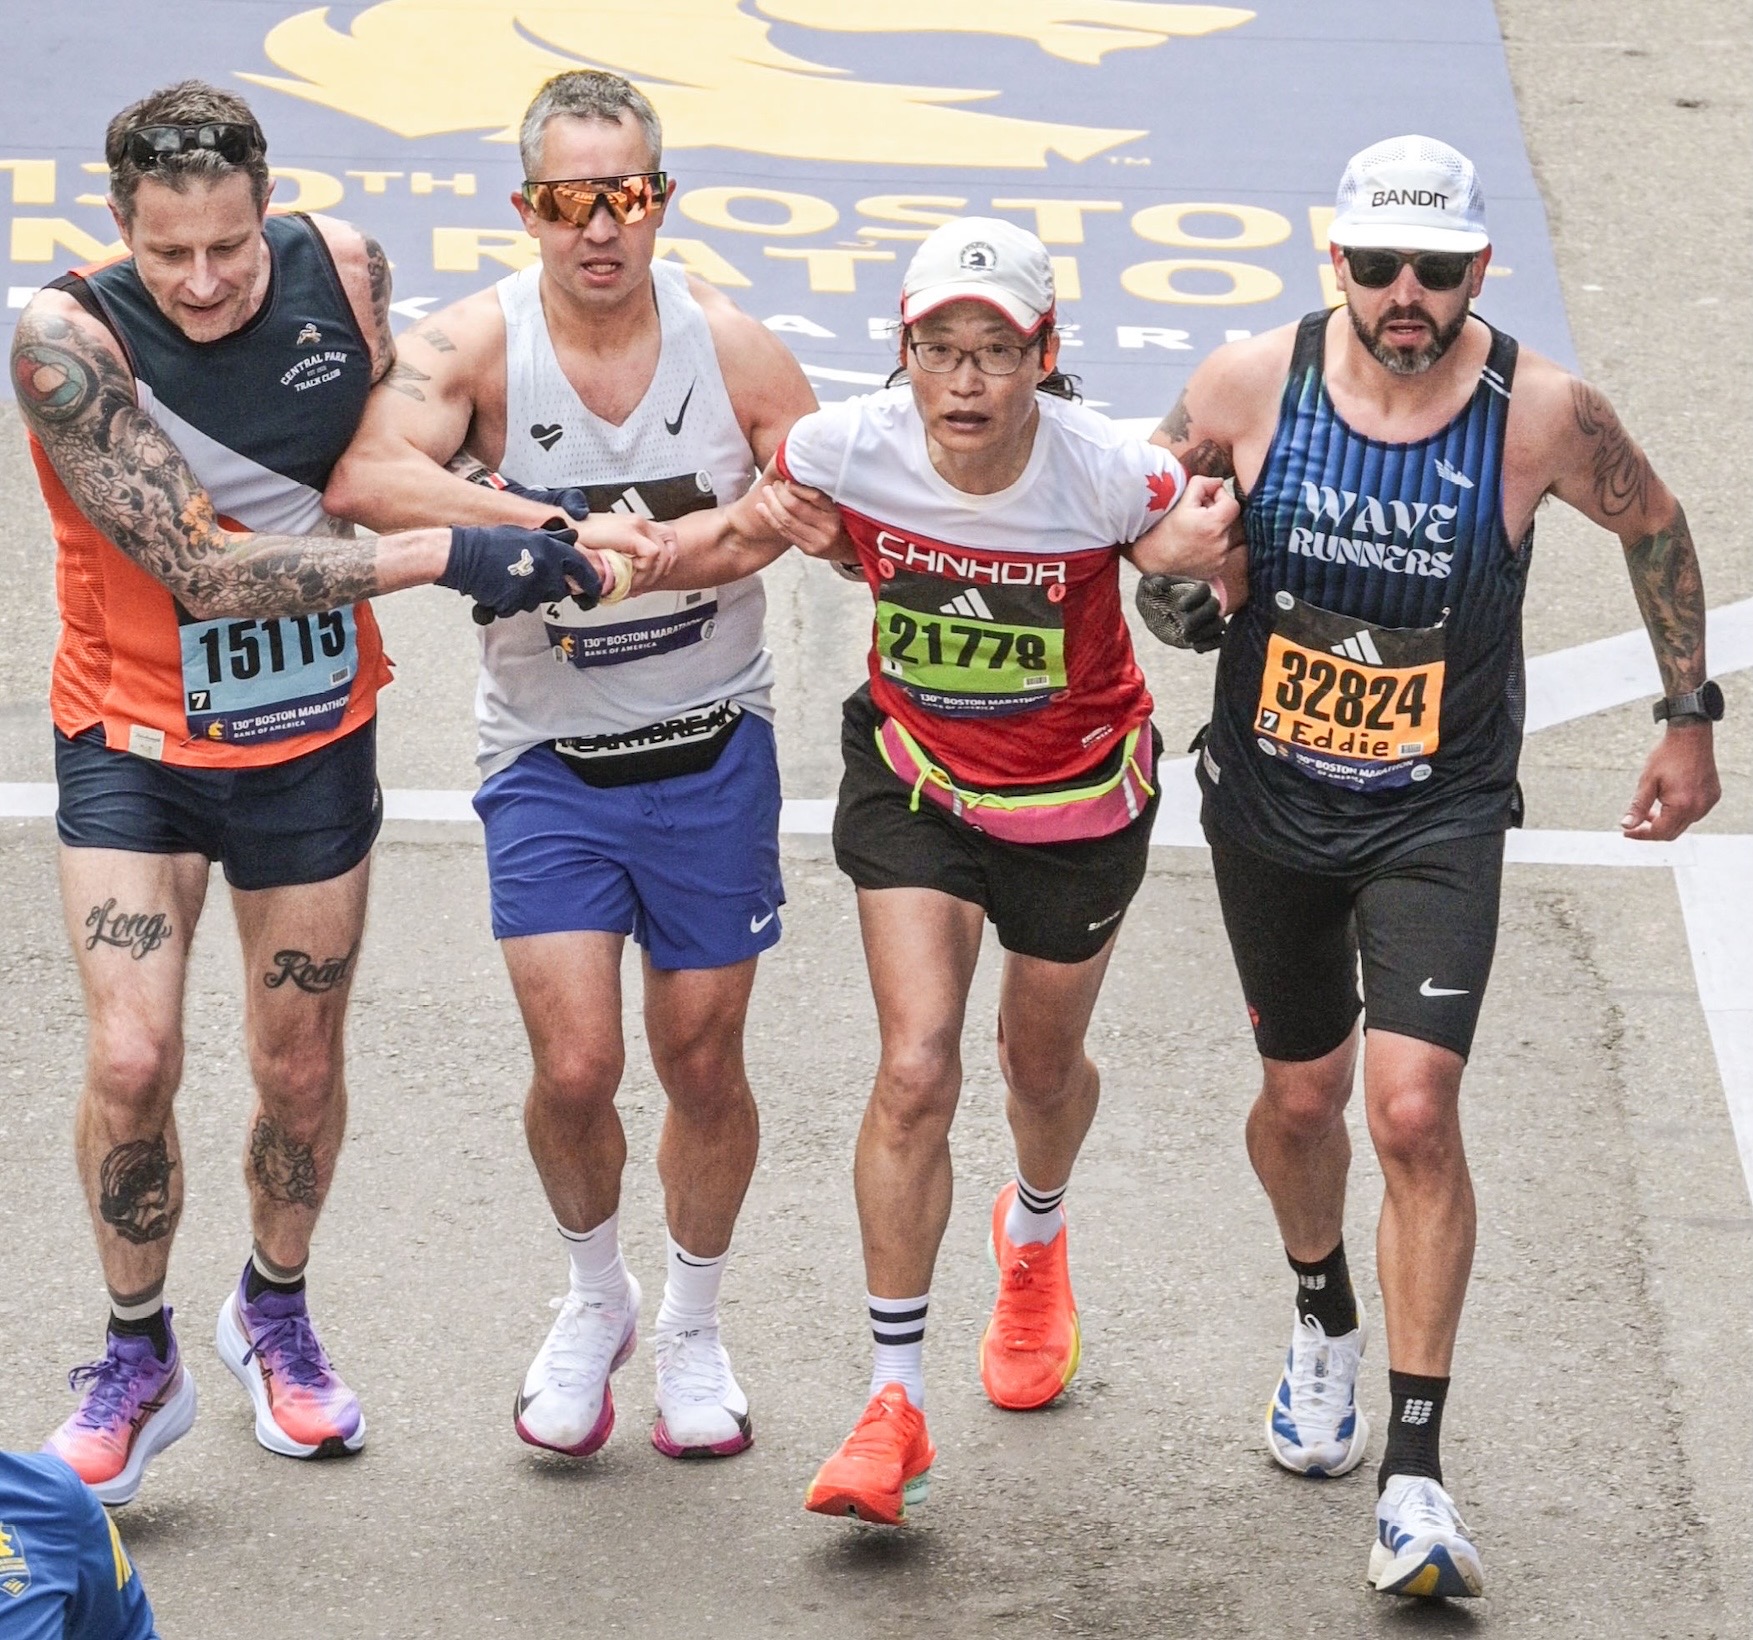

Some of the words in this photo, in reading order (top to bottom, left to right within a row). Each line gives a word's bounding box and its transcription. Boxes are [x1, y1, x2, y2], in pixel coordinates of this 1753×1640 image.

[1371, 189, 1449, 210] BANDIT
[280, 354, 324, 386] CENTRAL
[324, 351, 348, 363] PARK
[294, 376, 322, 391] TRACK
[321, 368, 341, 383] CLUB
[1301, 481, 1458, 543] WAVE
[1288, 526, 1454, 579] RUNNERS
[546, 603, 560, 619] 4
[199, 610, 345, 684] 15115
[585, 648, 608, 657] BANK
[609, 646, 619, 654] OF
[620, 641, 658, 652] AMERICA
[606, 630, 650, 647] BOSTON
[889, 612, 1047, 670] 21778
[191, 692, 208, 710] 7
[943, 696, 987, 706] BOSTON
[1276, 649, 1429, 731] 32824
[255, 709, 297, 727] BOSTON
[1262, 710, 1278, 728] 7
[234, 730, 256, 739] BANK
[269, 720, 306, 732] AMERICA
[1290, 720, 1390, 757] Eddie
[1315, 759, 1359, 775] BOSTON
[85, 897, 172, 960] Long
[263, 934, 360, 993] Road
